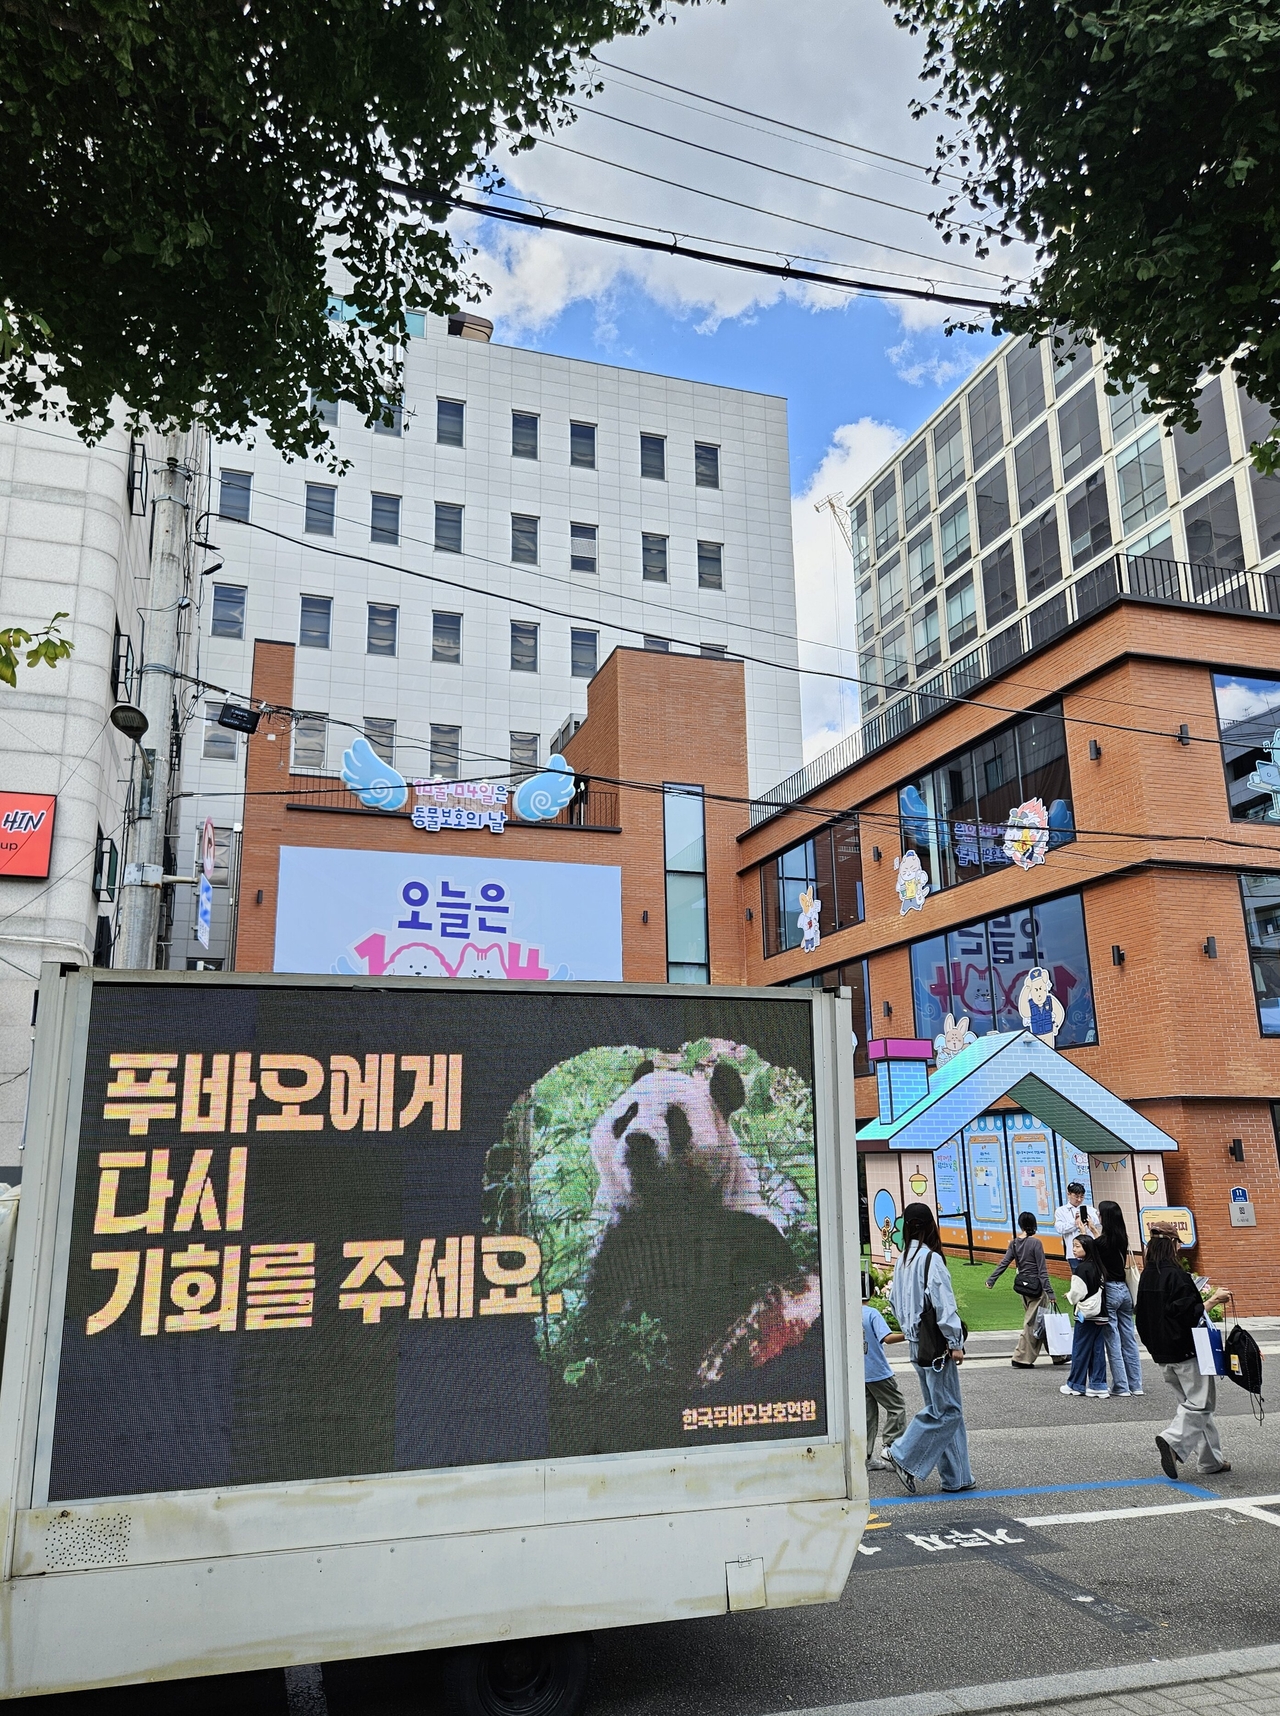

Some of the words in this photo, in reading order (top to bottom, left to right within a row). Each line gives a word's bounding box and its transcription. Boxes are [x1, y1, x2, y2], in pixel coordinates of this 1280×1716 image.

[2, 809, 46, 833] HIN
[413, 807, 483, 830] 동물보호의
[488, 811, 508, 832] 날
[397, 880, 510, 940] 오늘은
[105, 1052, 463, 1136] 푸바오에게
[94, 1147, 247, 1236] 다시
[86, 1243, 316, 1337] 기회를
[682, 1399, 817, 1431] 한국푸바오보호연합
